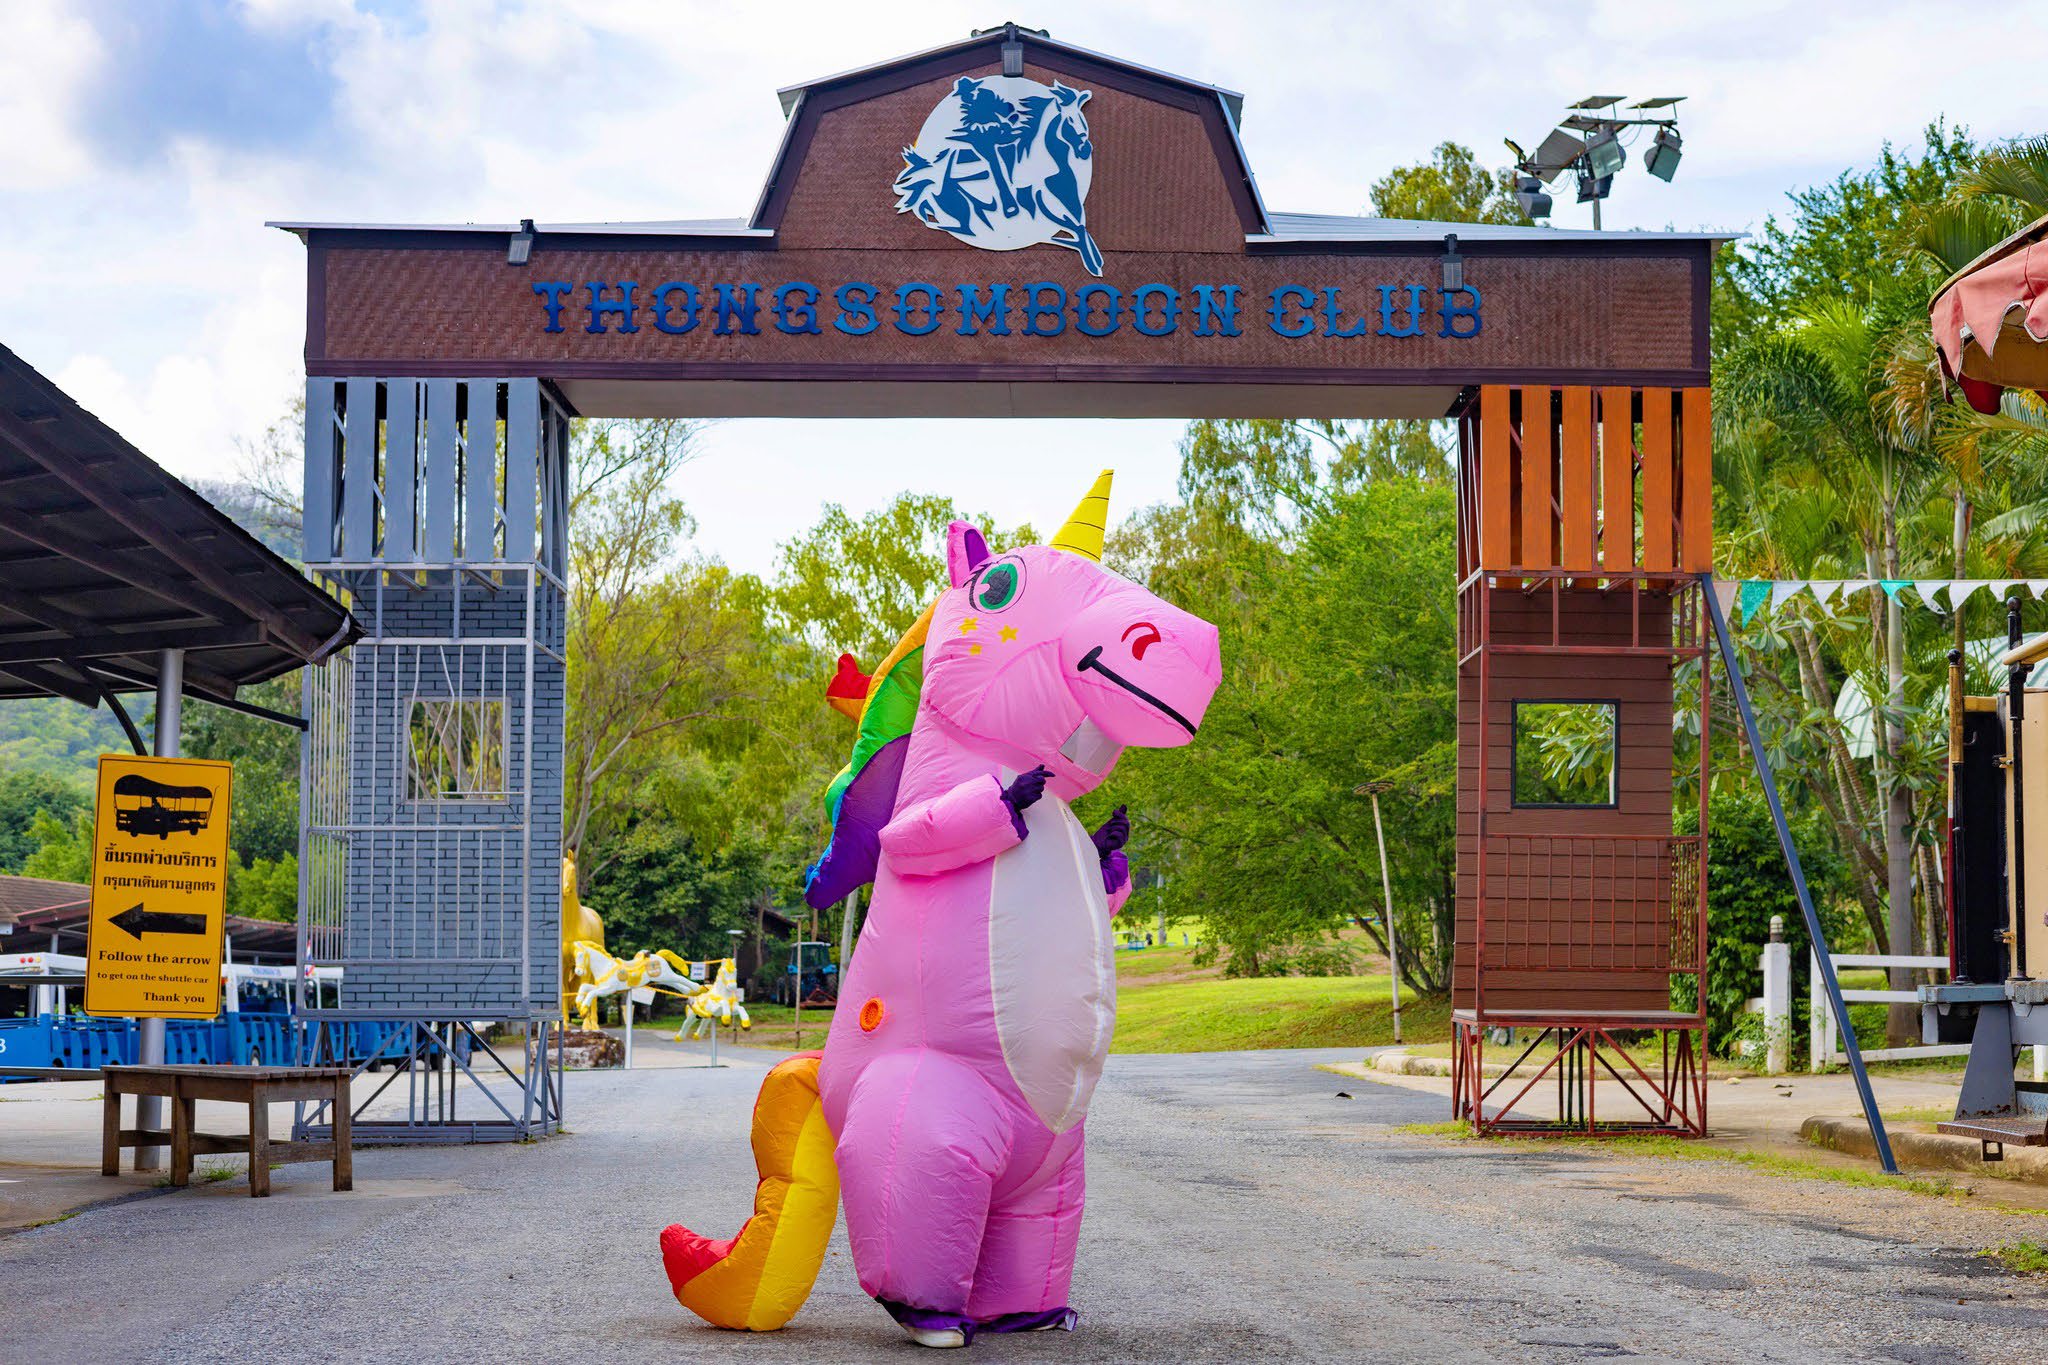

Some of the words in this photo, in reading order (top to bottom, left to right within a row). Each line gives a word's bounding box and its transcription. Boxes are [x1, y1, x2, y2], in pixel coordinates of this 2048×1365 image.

[532, 281, 1243, 337] THONGSOMBOON
[1266, 284, 1483, 338] CLUB
[103, 875, 216, 894] กรุณาเดินตามลูกศร
[99, 950, 143, 962] Follow
[146, 953, 169, 964] the
[171, 956, 211, 965] arrow
[109, 973, 124, 981] get
[140, 973, 157, 982] the
[158, 974, 192, 984] shuttle
[143, 992, 181, 1003] Thank
[183, 996, 205, 1005] you
